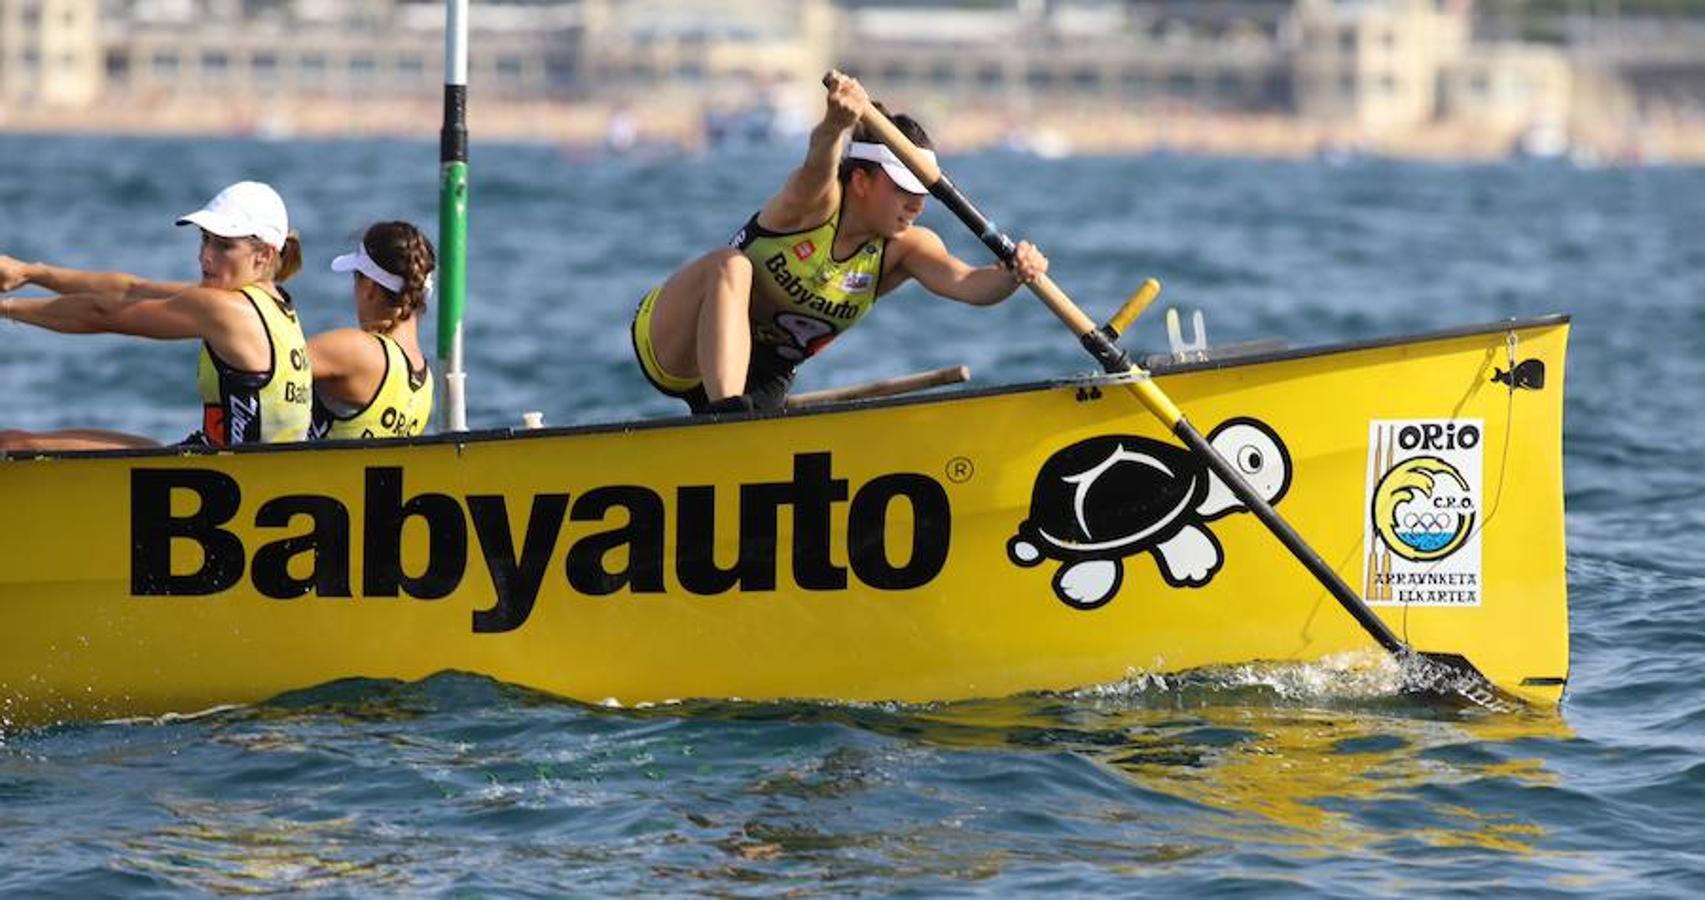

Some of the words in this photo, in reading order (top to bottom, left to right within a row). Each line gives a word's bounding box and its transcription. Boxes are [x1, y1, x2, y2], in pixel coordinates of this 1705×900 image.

[765, 251, 860, 320] Babyauto
[130, 452, 952, 633] Babyauto
[1398, 591, 1477, 602] ELKARTEA
